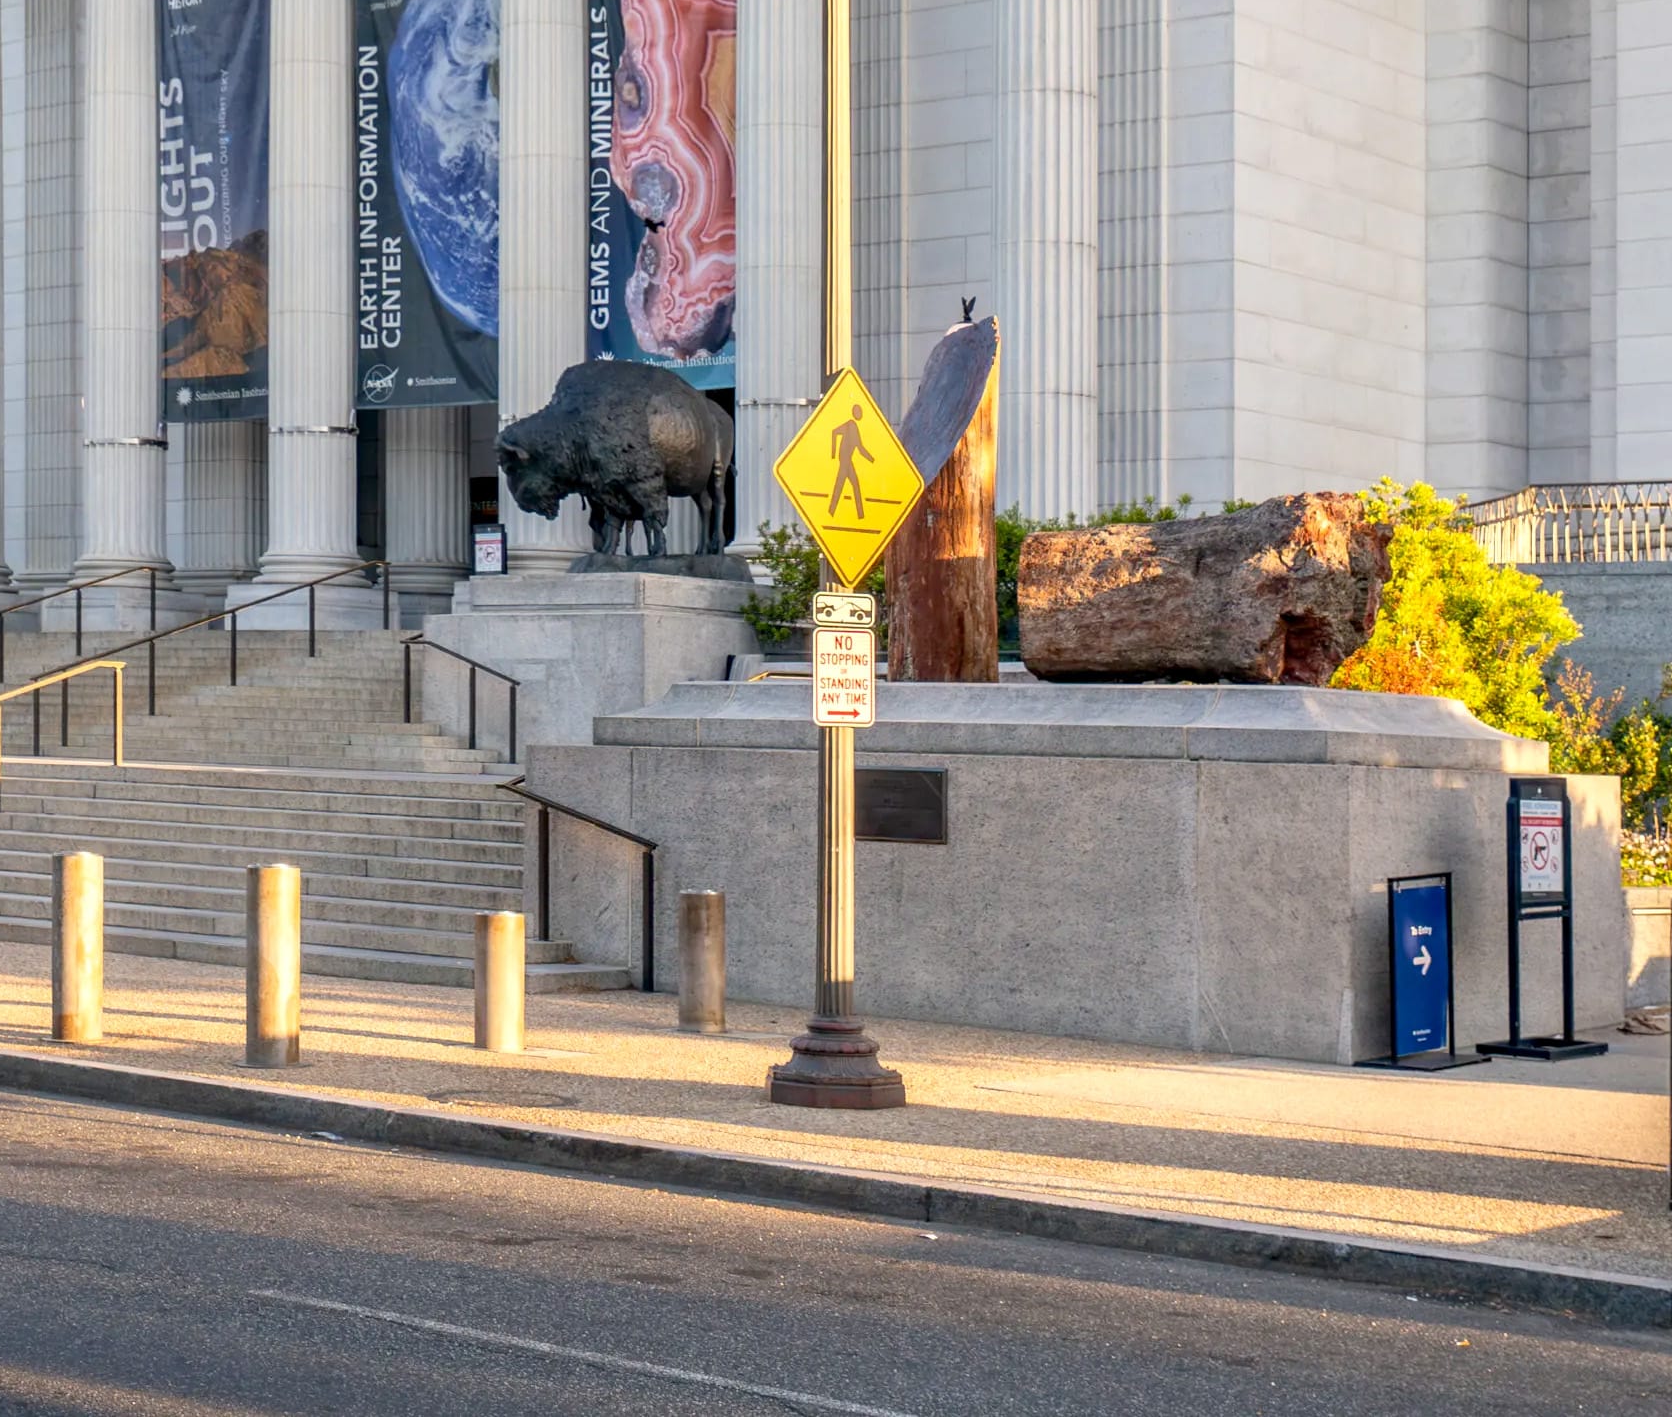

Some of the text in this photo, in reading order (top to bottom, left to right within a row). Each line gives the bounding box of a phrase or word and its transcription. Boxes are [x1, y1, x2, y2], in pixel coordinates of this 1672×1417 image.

[160, 77, 190, 261] LIGHTS
[190, 145, 218, 253] OUT
[359, 46, 378, 349] EARTH INFORMATION
[590, 6, 613, 329] GEMS AND MINERALS
[382, 236, 402, 349] CENTER
[820, 653, 868, 667] STOPPING
[820, 677, 868, 690] STANDING
[835, 636, 852, 650] NO
[821, 692, 868, 705] ANY TIME
